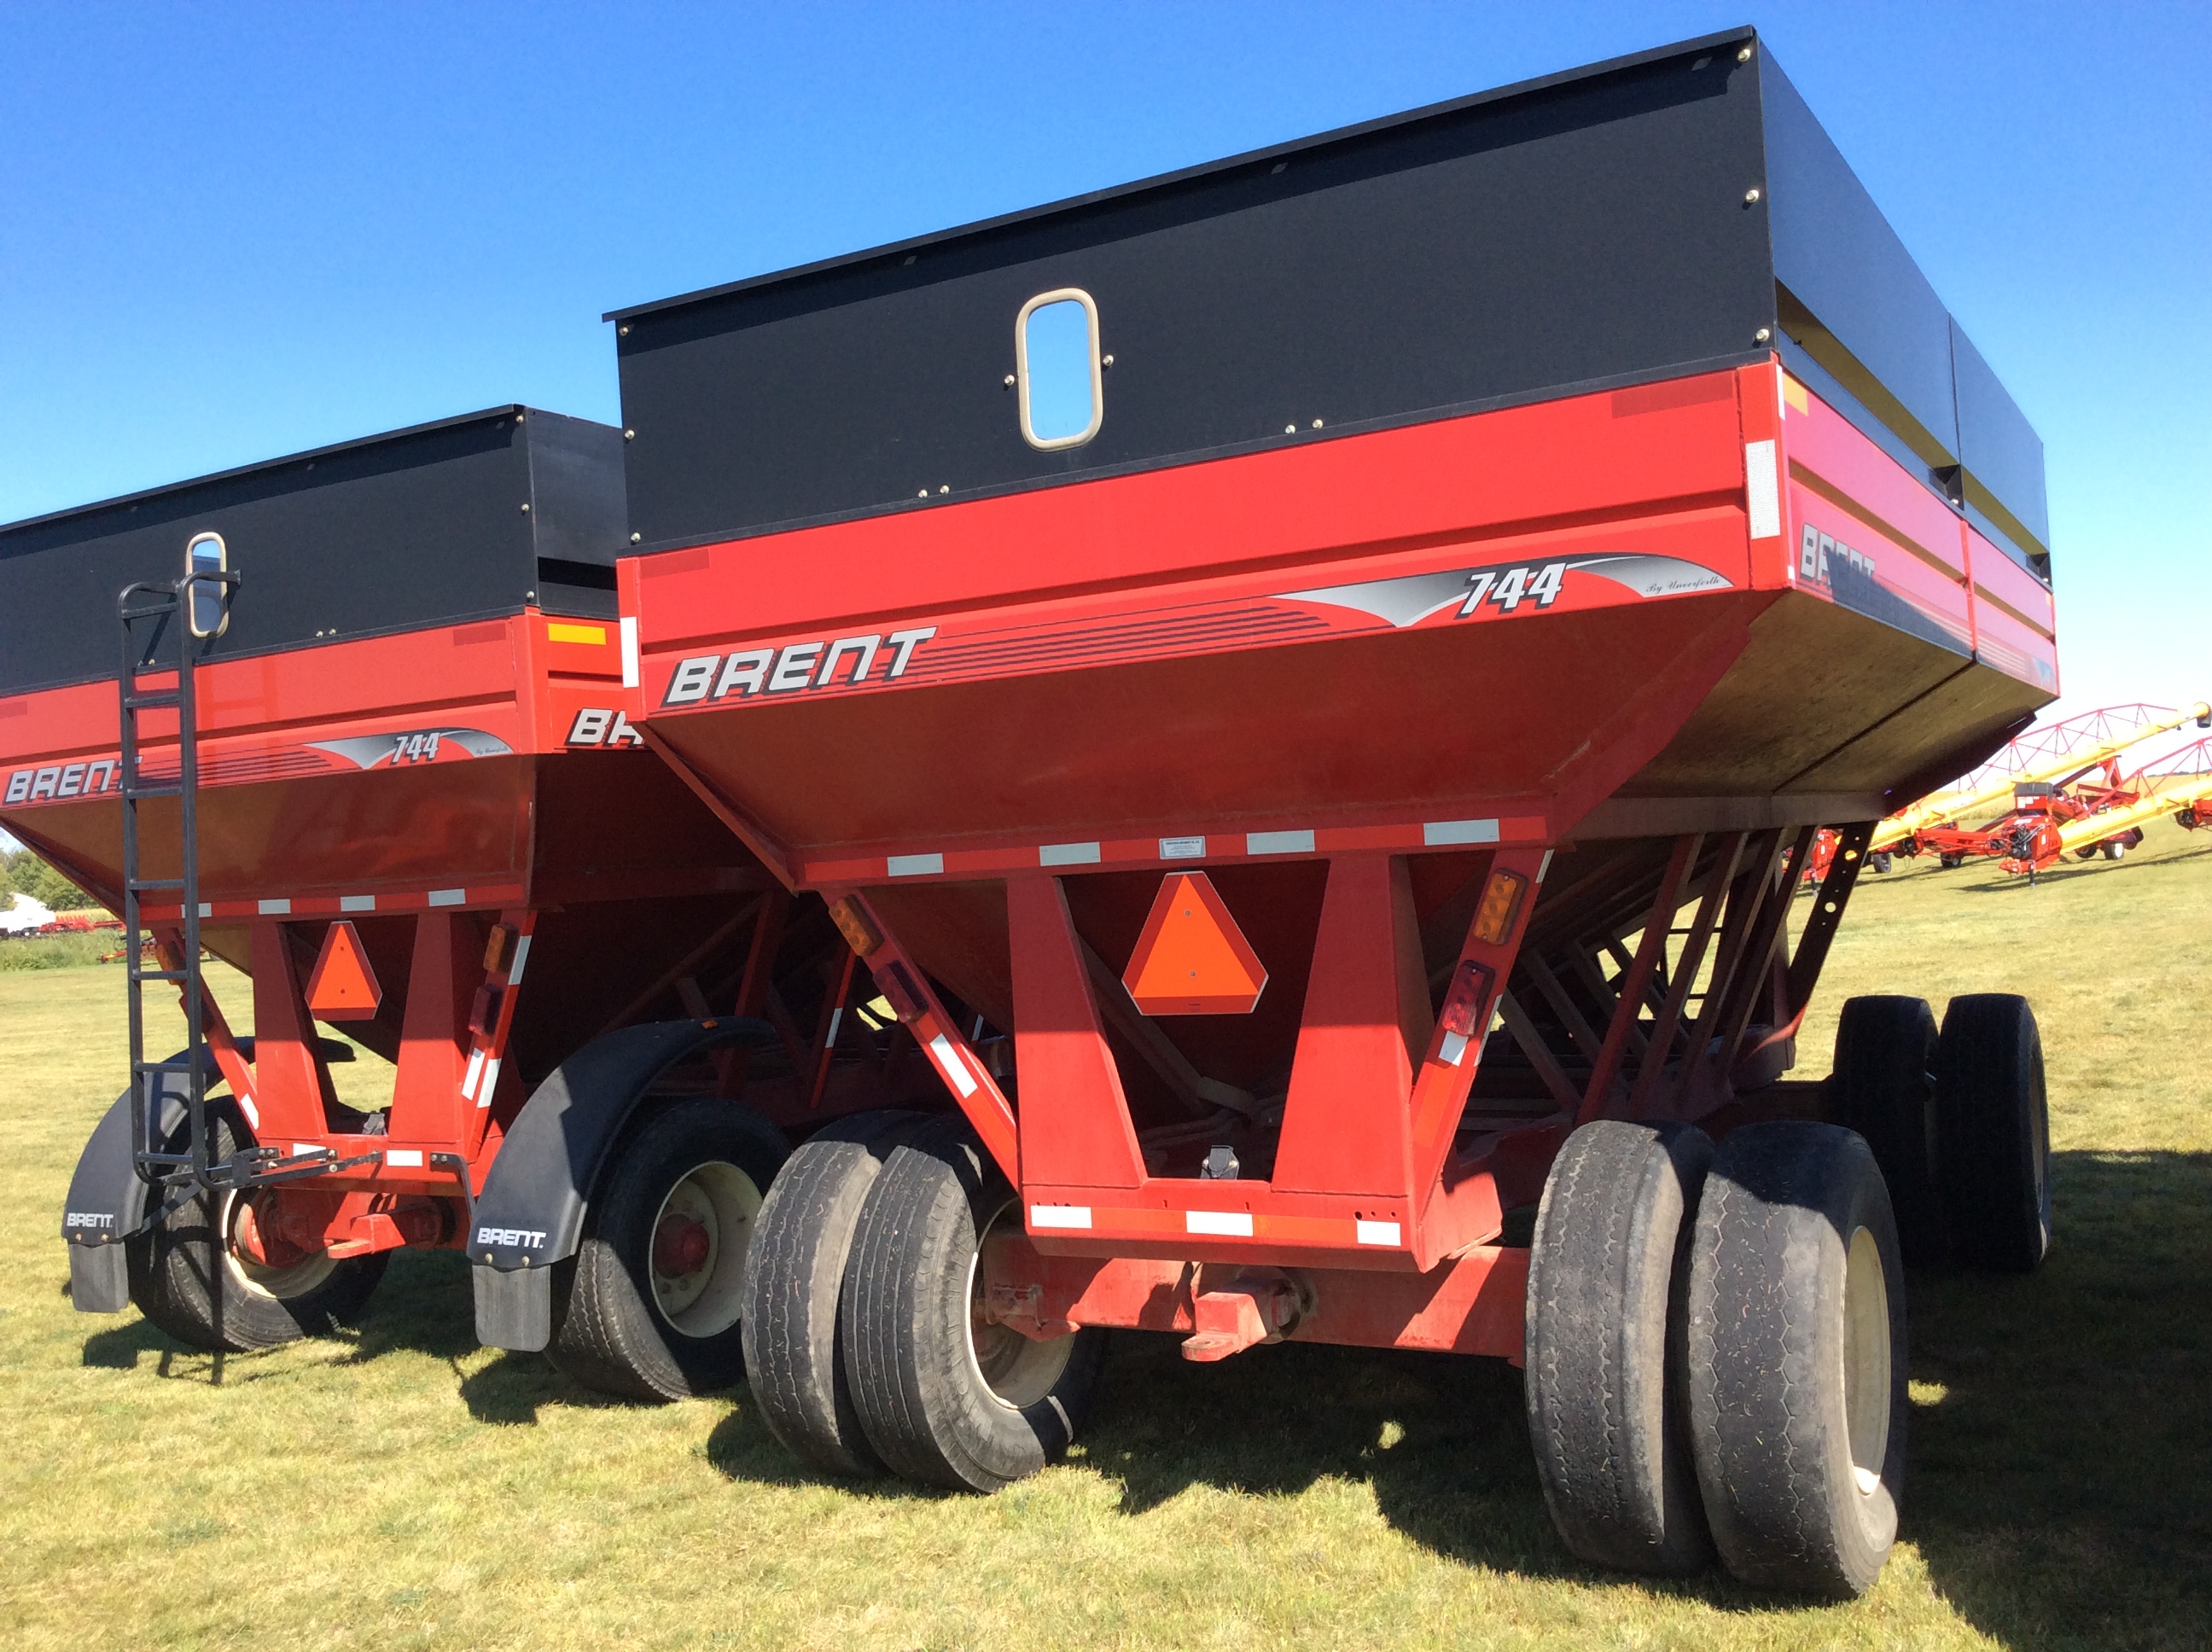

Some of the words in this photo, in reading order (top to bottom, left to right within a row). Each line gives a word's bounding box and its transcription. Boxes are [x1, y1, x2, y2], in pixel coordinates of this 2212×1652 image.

[1457, 562, 1566, 616] 744
[1645, 583, 1662, 595] By
[663, 625, 938, 706] BRENT
[391, 731, 440, 764] 744
[67, 1213, 114, 1228] BRENT
[477, 1227, 546, 1248] BRENT
